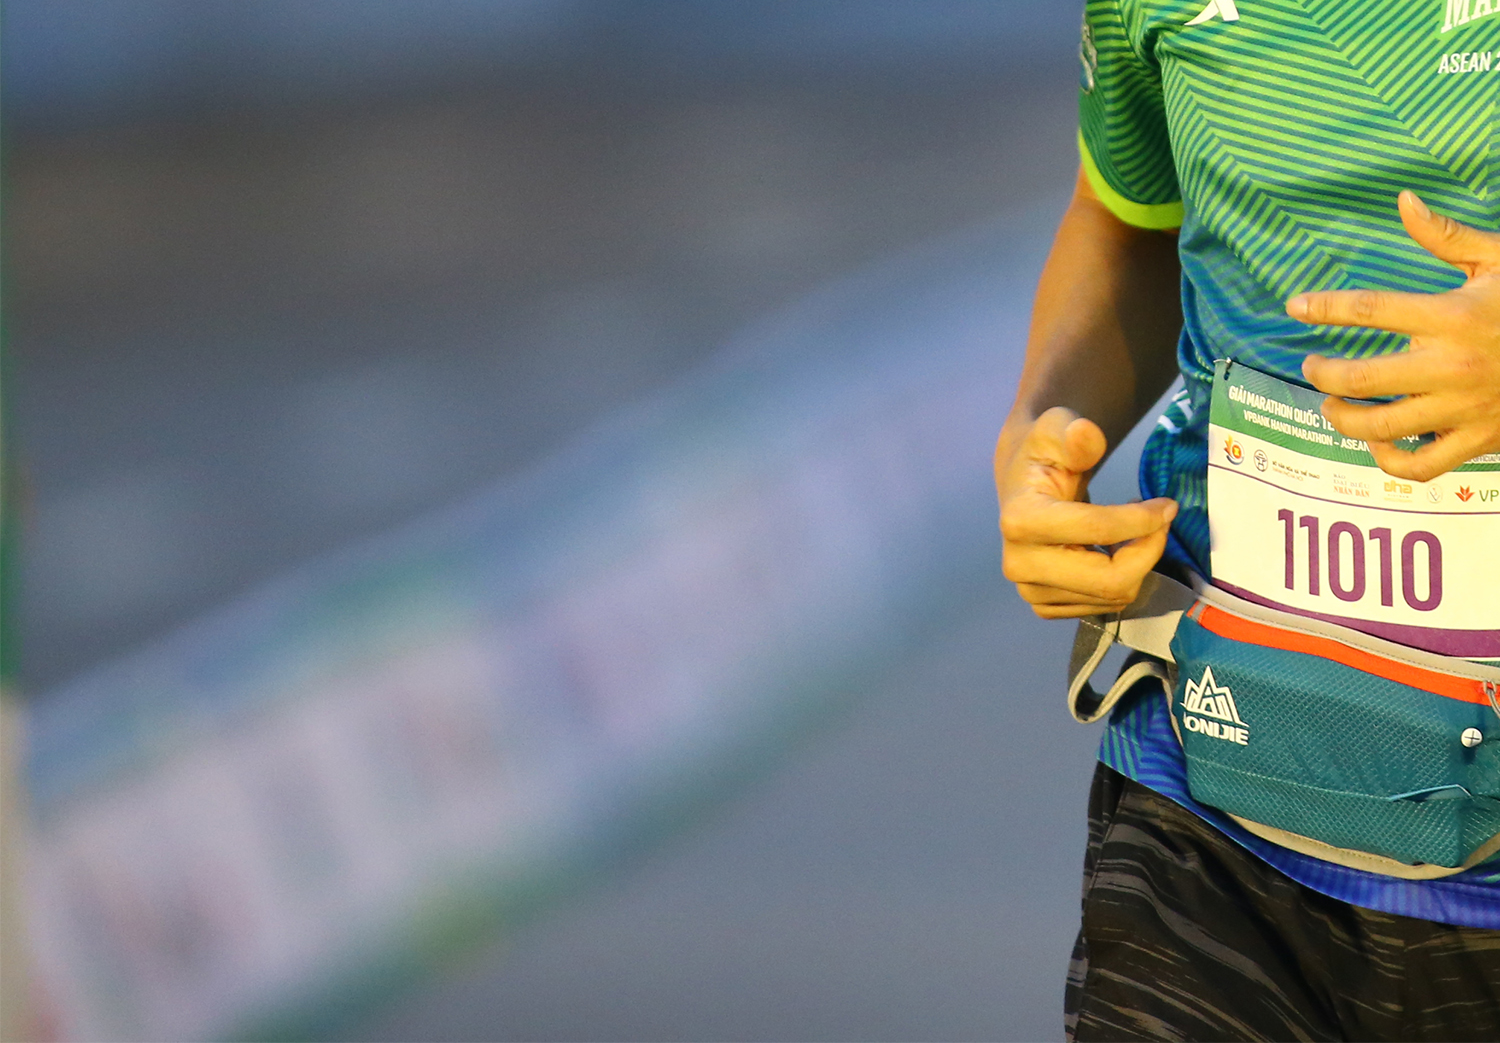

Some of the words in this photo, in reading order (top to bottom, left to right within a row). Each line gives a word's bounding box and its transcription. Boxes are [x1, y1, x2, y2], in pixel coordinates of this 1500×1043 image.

[1438, 51, 1492, 74] ASEAN
[1228, 385, 1247, 404] GIẢI
[1246, 391, 1293, 420] MARATHON
[1294, 408, 1320, 428] QUỐC
[1243, 410, 1271, 429] VPBANK
[1271, 419, 1292, 436] HANOI
[1291, 425, 1333, 447] MARATHON
[1277, 508, 1443, 612] 11010
